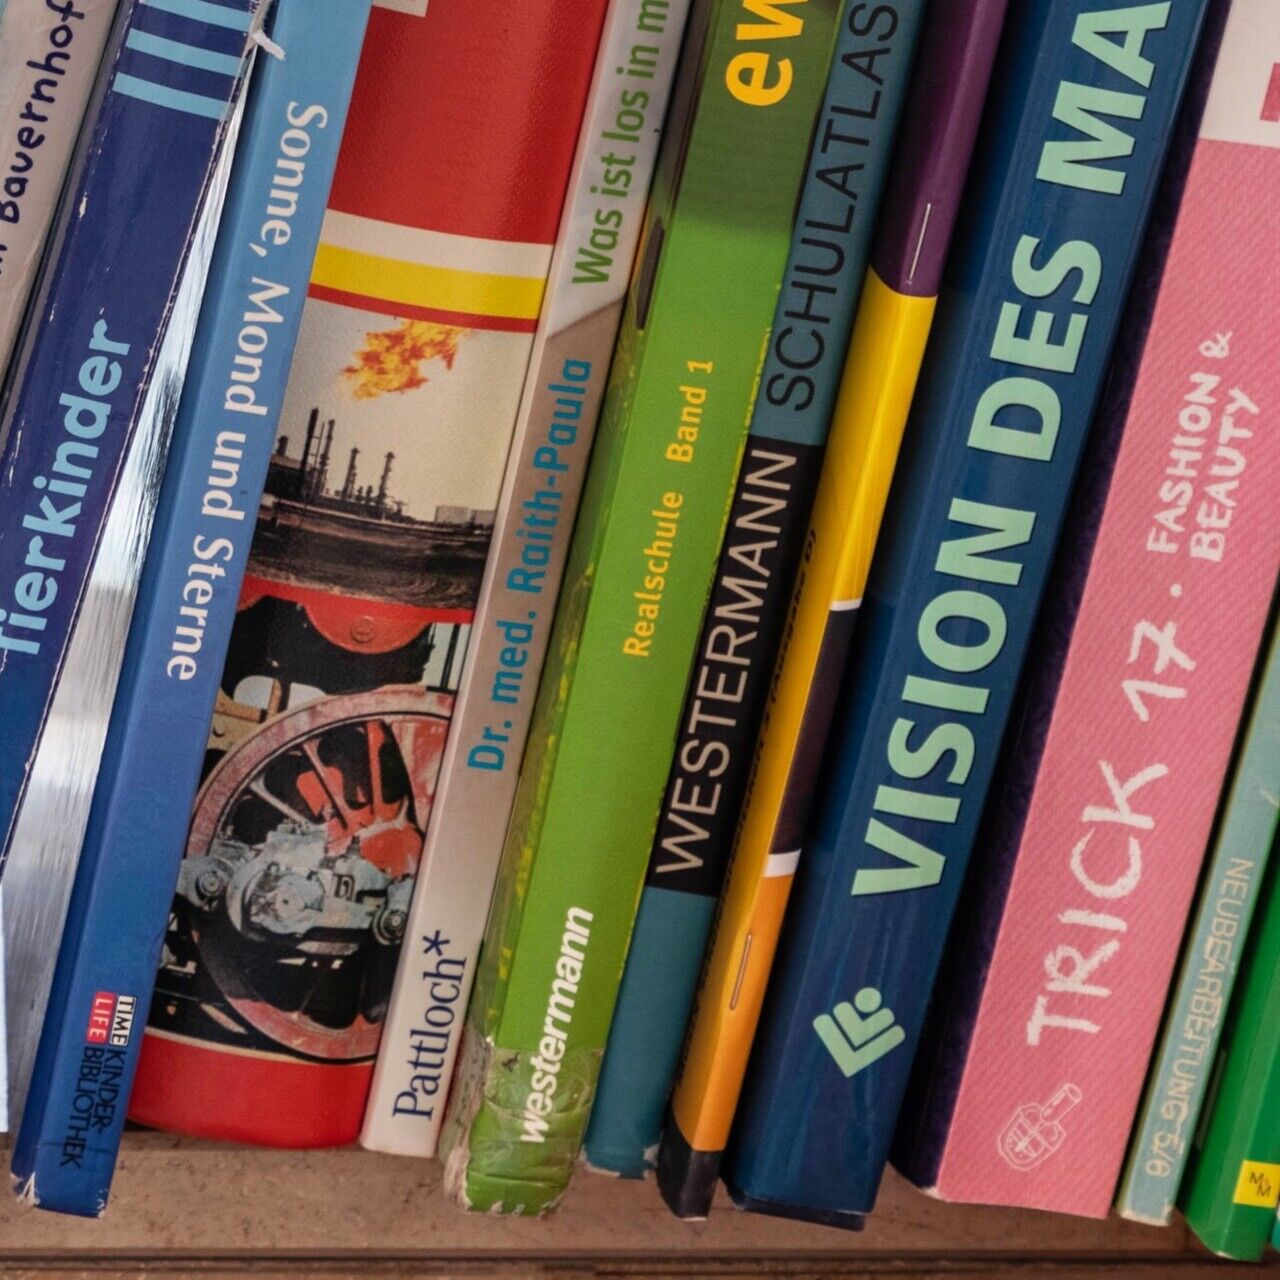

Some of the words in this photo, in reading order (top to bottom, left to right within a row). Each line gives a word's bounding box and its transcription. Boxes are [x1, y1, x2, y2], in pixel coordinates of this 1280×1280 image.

[602, 90, 649, 157] los
[616, 30, 661, 80] in
[249, 100, 329, 258] Sonne,
[572, 207, 624, 285] Was
[589, 150, 636, 199] ist
[224, 277, 291, 417] Mond
[201, 432, 246, 522] und
[507, 358, 592, 593] Raith-Paula
[657, 448, 798, 874] WESTERMANN
[765, 0, 899, 412] SCHULATLAS
[1147, 372, 1221, 554] FASHION
[1190, 386, 1260, 562] BEAUTY
[623, 490, 685, 657] Realschule
[665, 384, 708, 463] Band
[850, 497, 1038, 899] VISION
[966, 233, 1103, 464] DES
[167, 534, 234, 682] Sterne
[492, 610, 538, 705] med.
[467, 719, 512, 772] Dr.
[1026, 759, 1170, 1047] TRICK
[1120, 619, 1196, 722] 17
[520, 905, 593, 1143] westermann
[61, 1046, 105, 1169] BIBLIOTHEK
